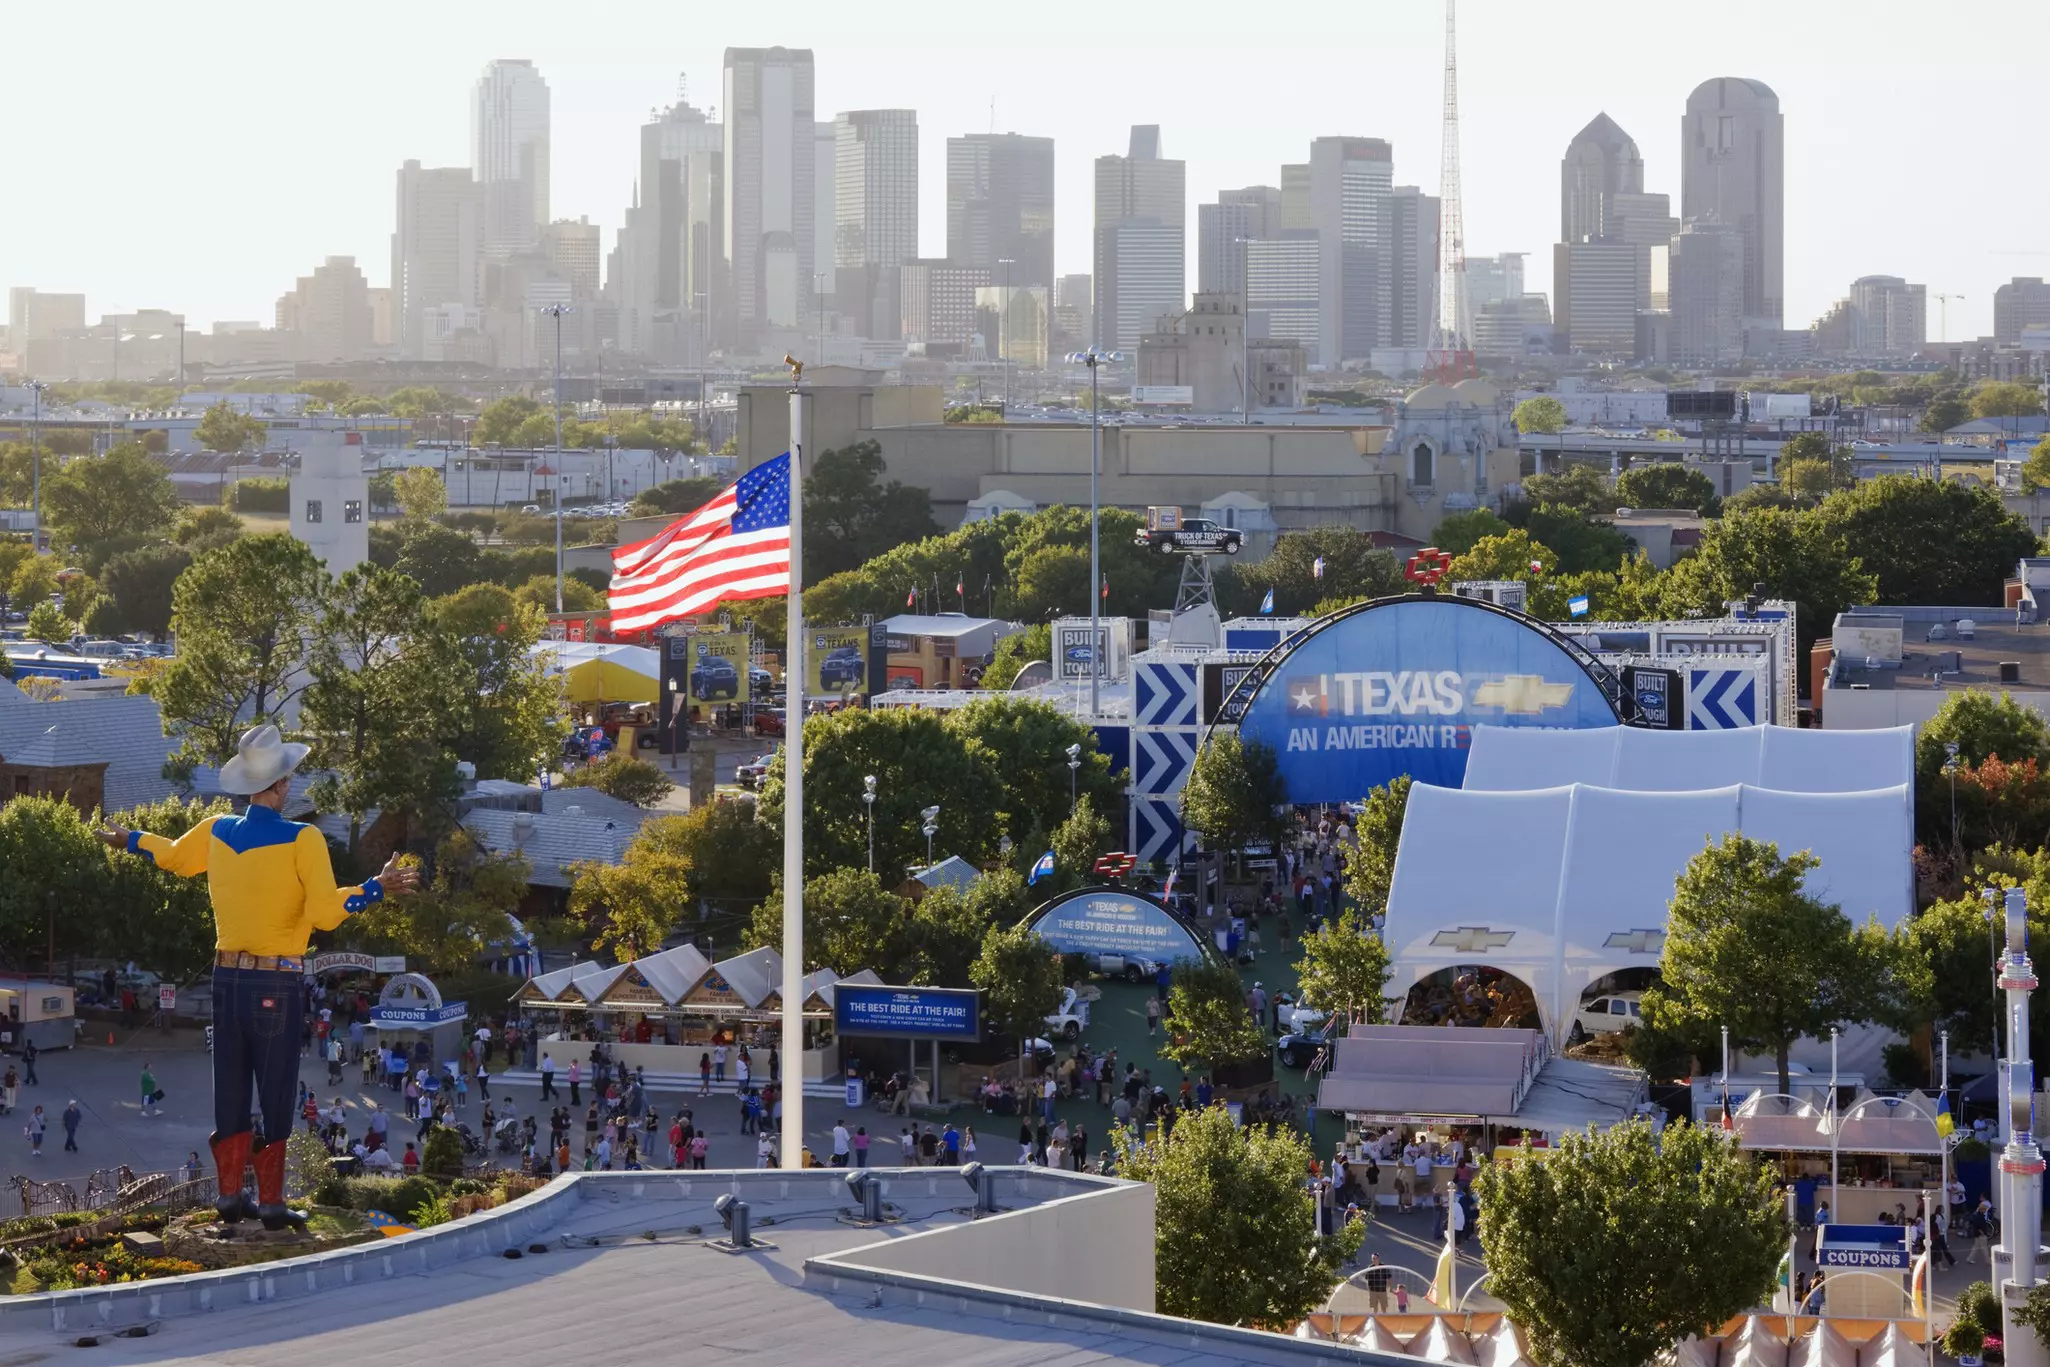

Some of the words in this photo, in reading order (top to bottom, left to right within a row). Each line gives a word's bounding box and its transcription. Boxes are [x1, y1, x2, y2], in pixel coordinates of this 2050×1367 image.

[1175, 532, 1195, 540] TRUCK
[1196, 532, 1202, 540] OF
[1203, 532, 1223, 540] TEXAS
[1637, 675, 1665, 691] BUILT
[1334, 671, 1463, 716] TEXAS
[1287, 727, 1318, 751] AN
[1325, 724, 1434, 751] AMERICAN
[1095, 902, 1118, 912] TEXAS
[1058, 919, 1074, 929] THE
[1075, 920, 1095, 931] BEST
[1096, 922, 1115, 933] RIDE
[1115, 923, 1128, 933] AT
[1129, 924, 1144, 934] THE
[1145, 925, 1167, 937] FAIR!
[316, 953, 354, 970] DOLLAR
[355, 956, 373, 970] DOG
[381, 1010, 426, 1020] COUPONS
[439, 1004, 465, 1020] COUPONS
[850, 1002, 866, 1012] THE
[868, 1003, 888, 1013] BEST
[890, 1004, 910, 1014] RIDE
[912, 1005, 924, 1014] AT
[925, 1006, 941, 1016] THE
[942, 1007, 966, 1017] FAIR!
[1827, 1251, 1900, 1266] COUPONS
